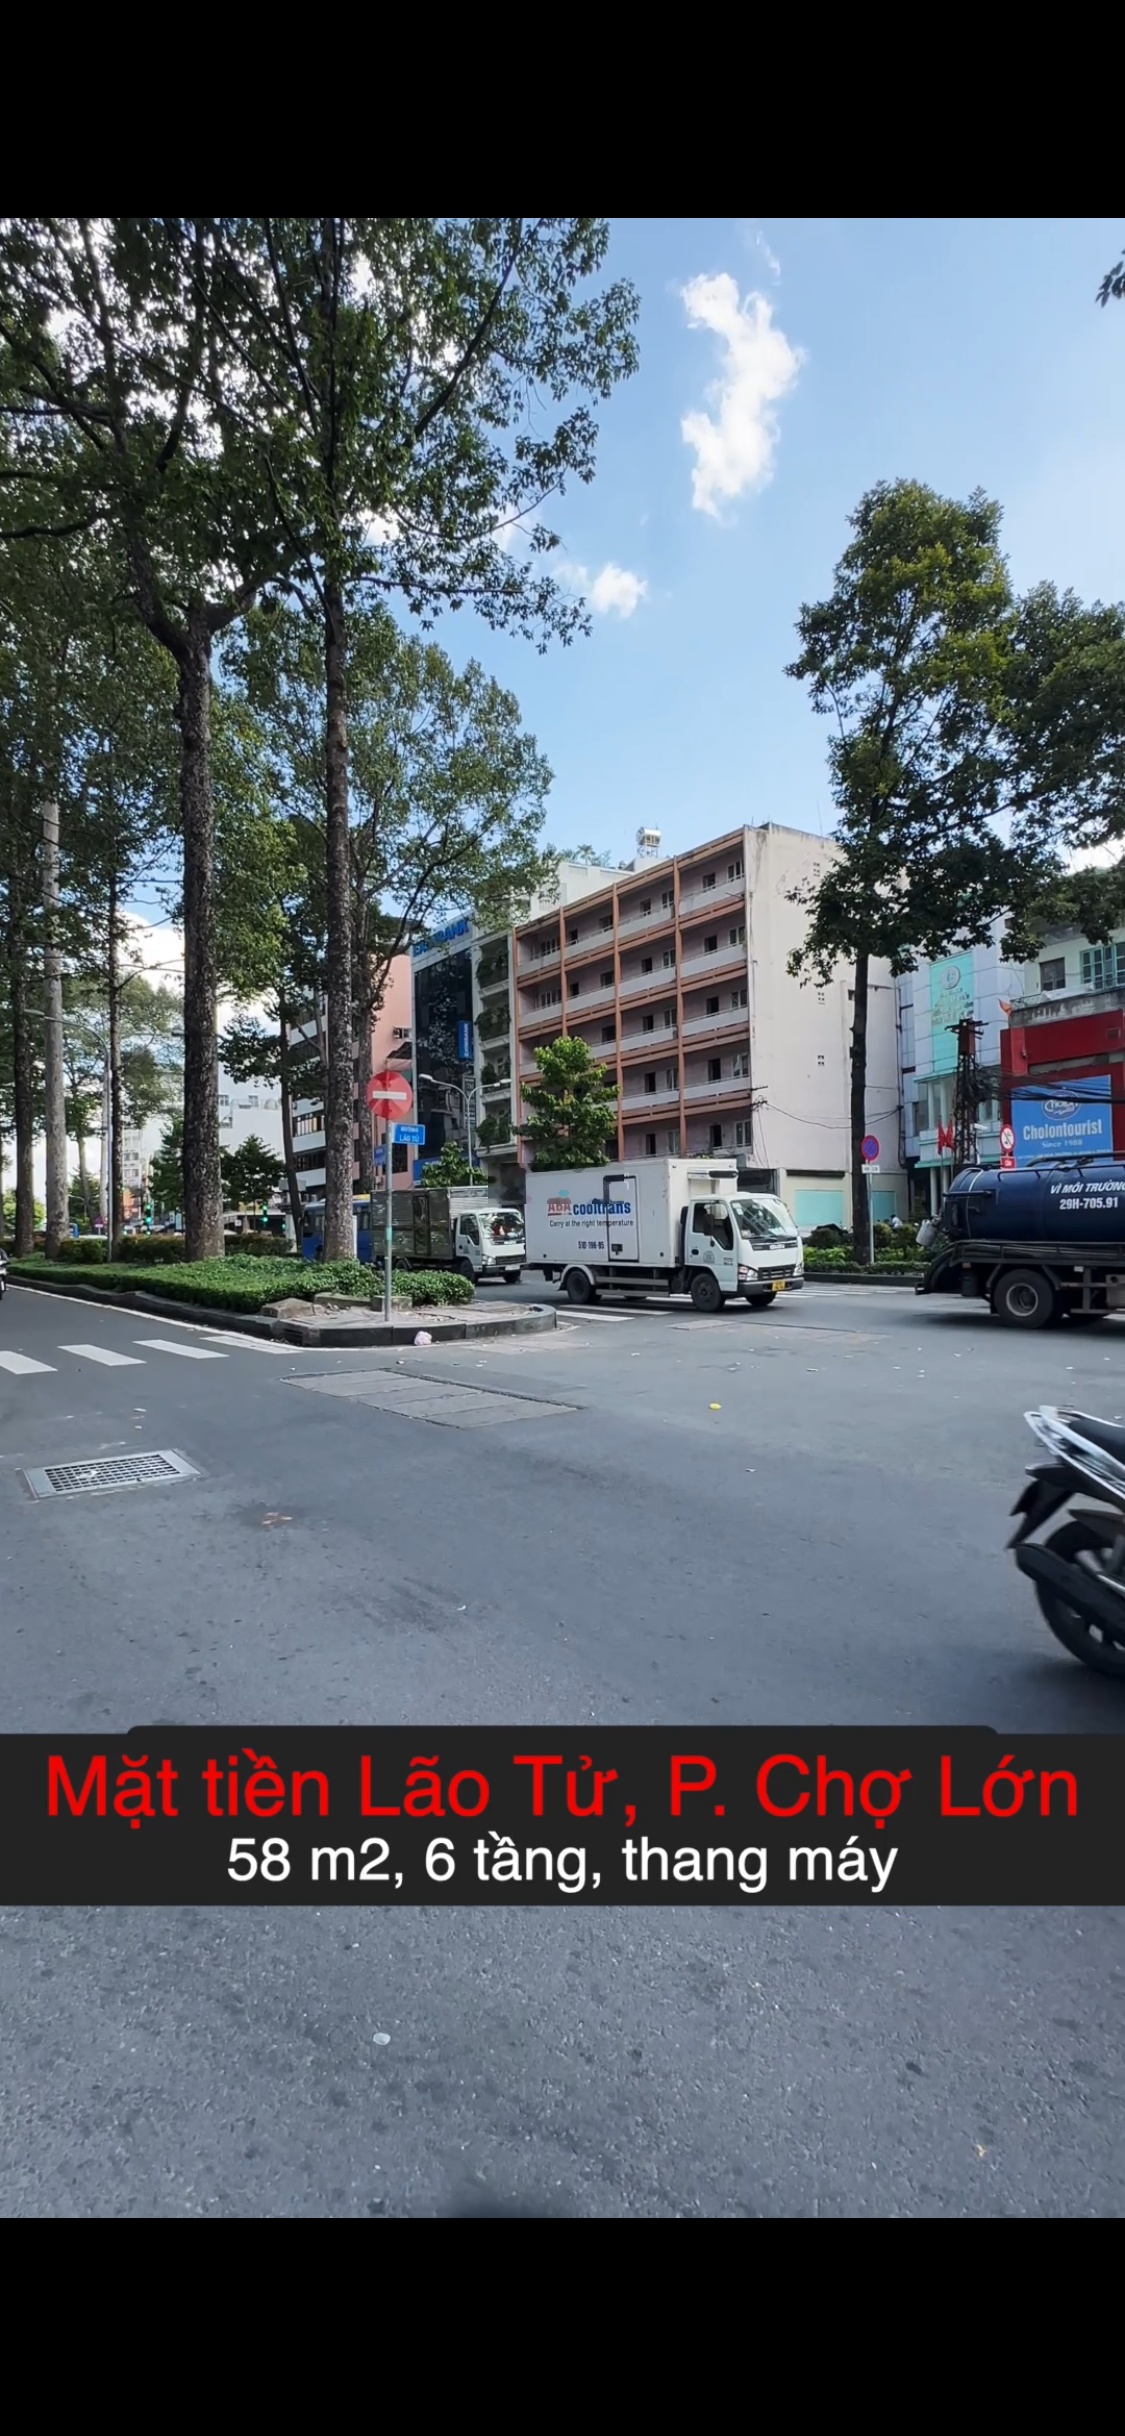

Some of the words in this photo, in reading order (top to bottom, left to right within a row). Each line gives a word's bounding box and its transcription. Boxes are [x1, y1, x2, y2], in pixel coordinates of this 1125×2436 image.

[1023, 1119, 1102, 1140] Cholontourist
[1041, 1141, 1062, 1149] Since
[573, 1199, 631, 1216] cooltrans
[1059, 1196, 1118, 1210] 29H-705.91
[549, 1220, 564, 1229] Carry
[571, 1219, 581, 1227] the
[581, 1219, 596, 1228] right
[596, 1219, 634, 1228] temperature
